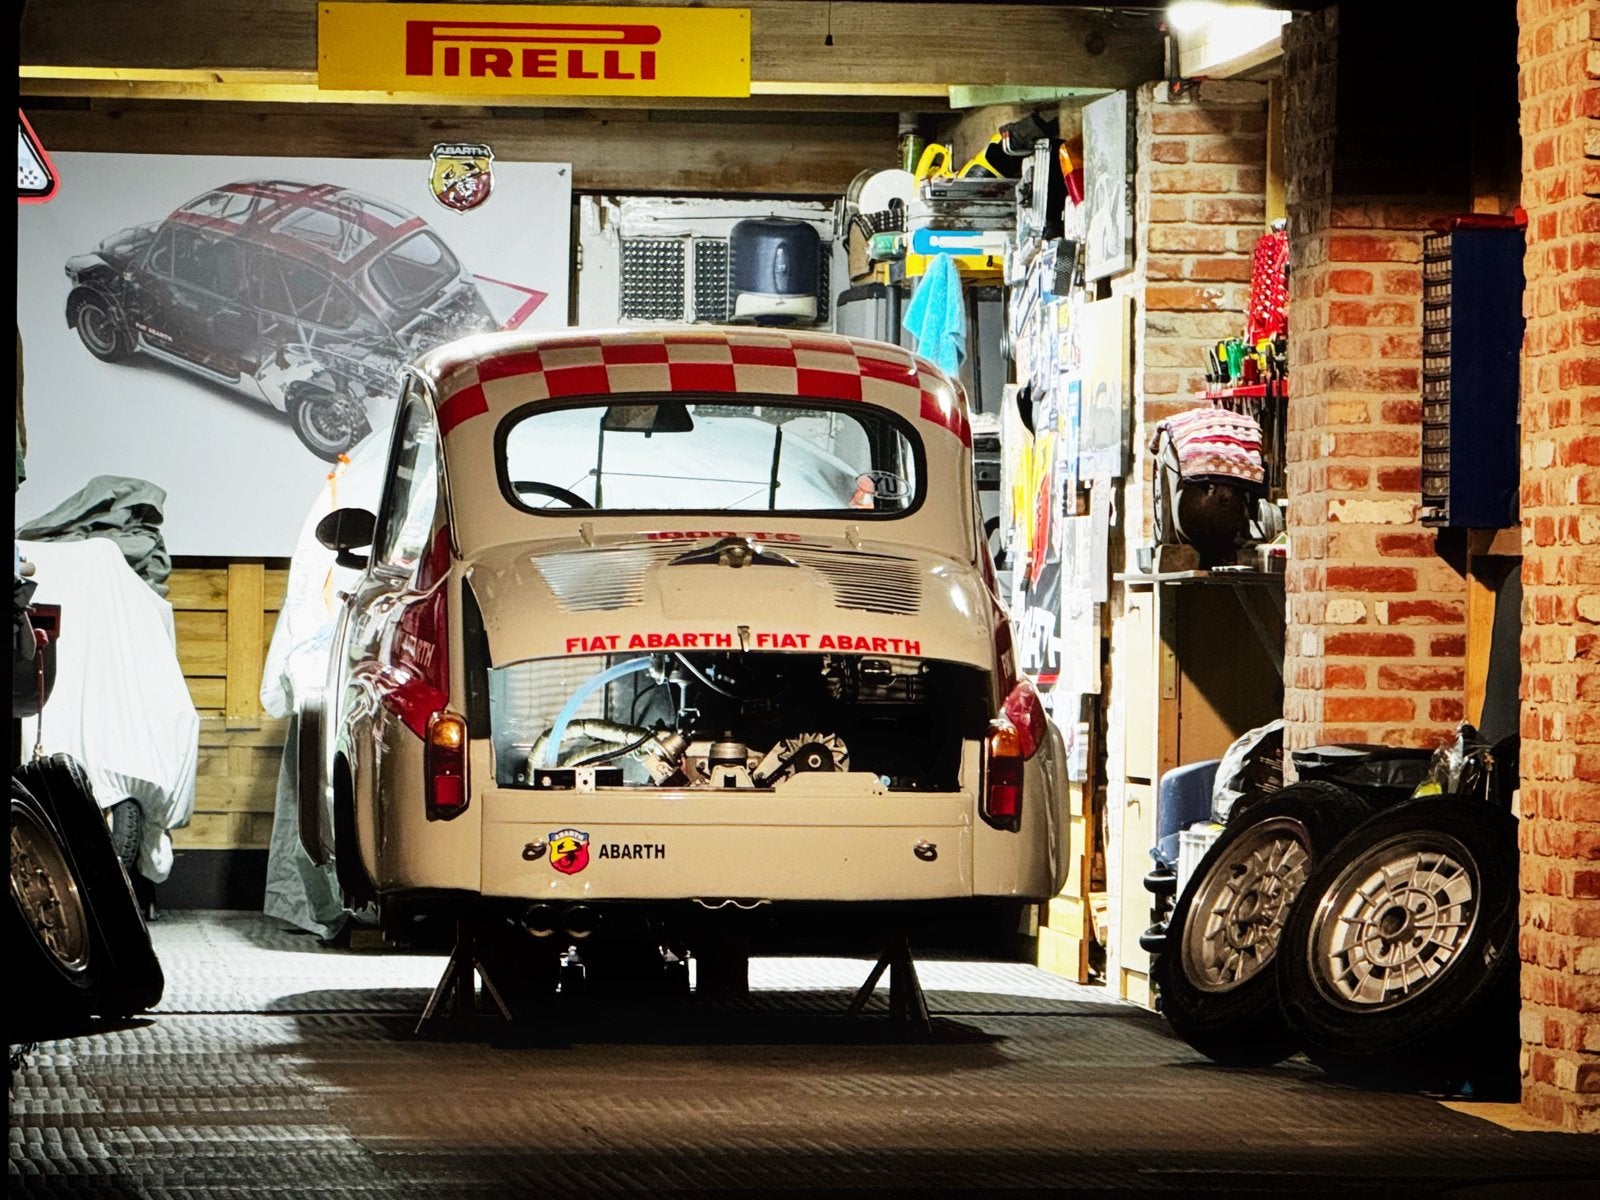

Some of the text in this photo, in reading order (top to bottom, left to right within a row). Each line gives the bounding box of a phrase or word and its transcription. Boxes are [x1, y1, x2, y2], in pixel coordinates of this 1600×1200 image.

[405, 20, 662, 80] PIRELLI
[436, 146, 489, 156] ABARTH
[566, 633, 921, 656] FIAT ABARTH FIAT ABARTH
[598, 843, 666, 859] ABARTH
